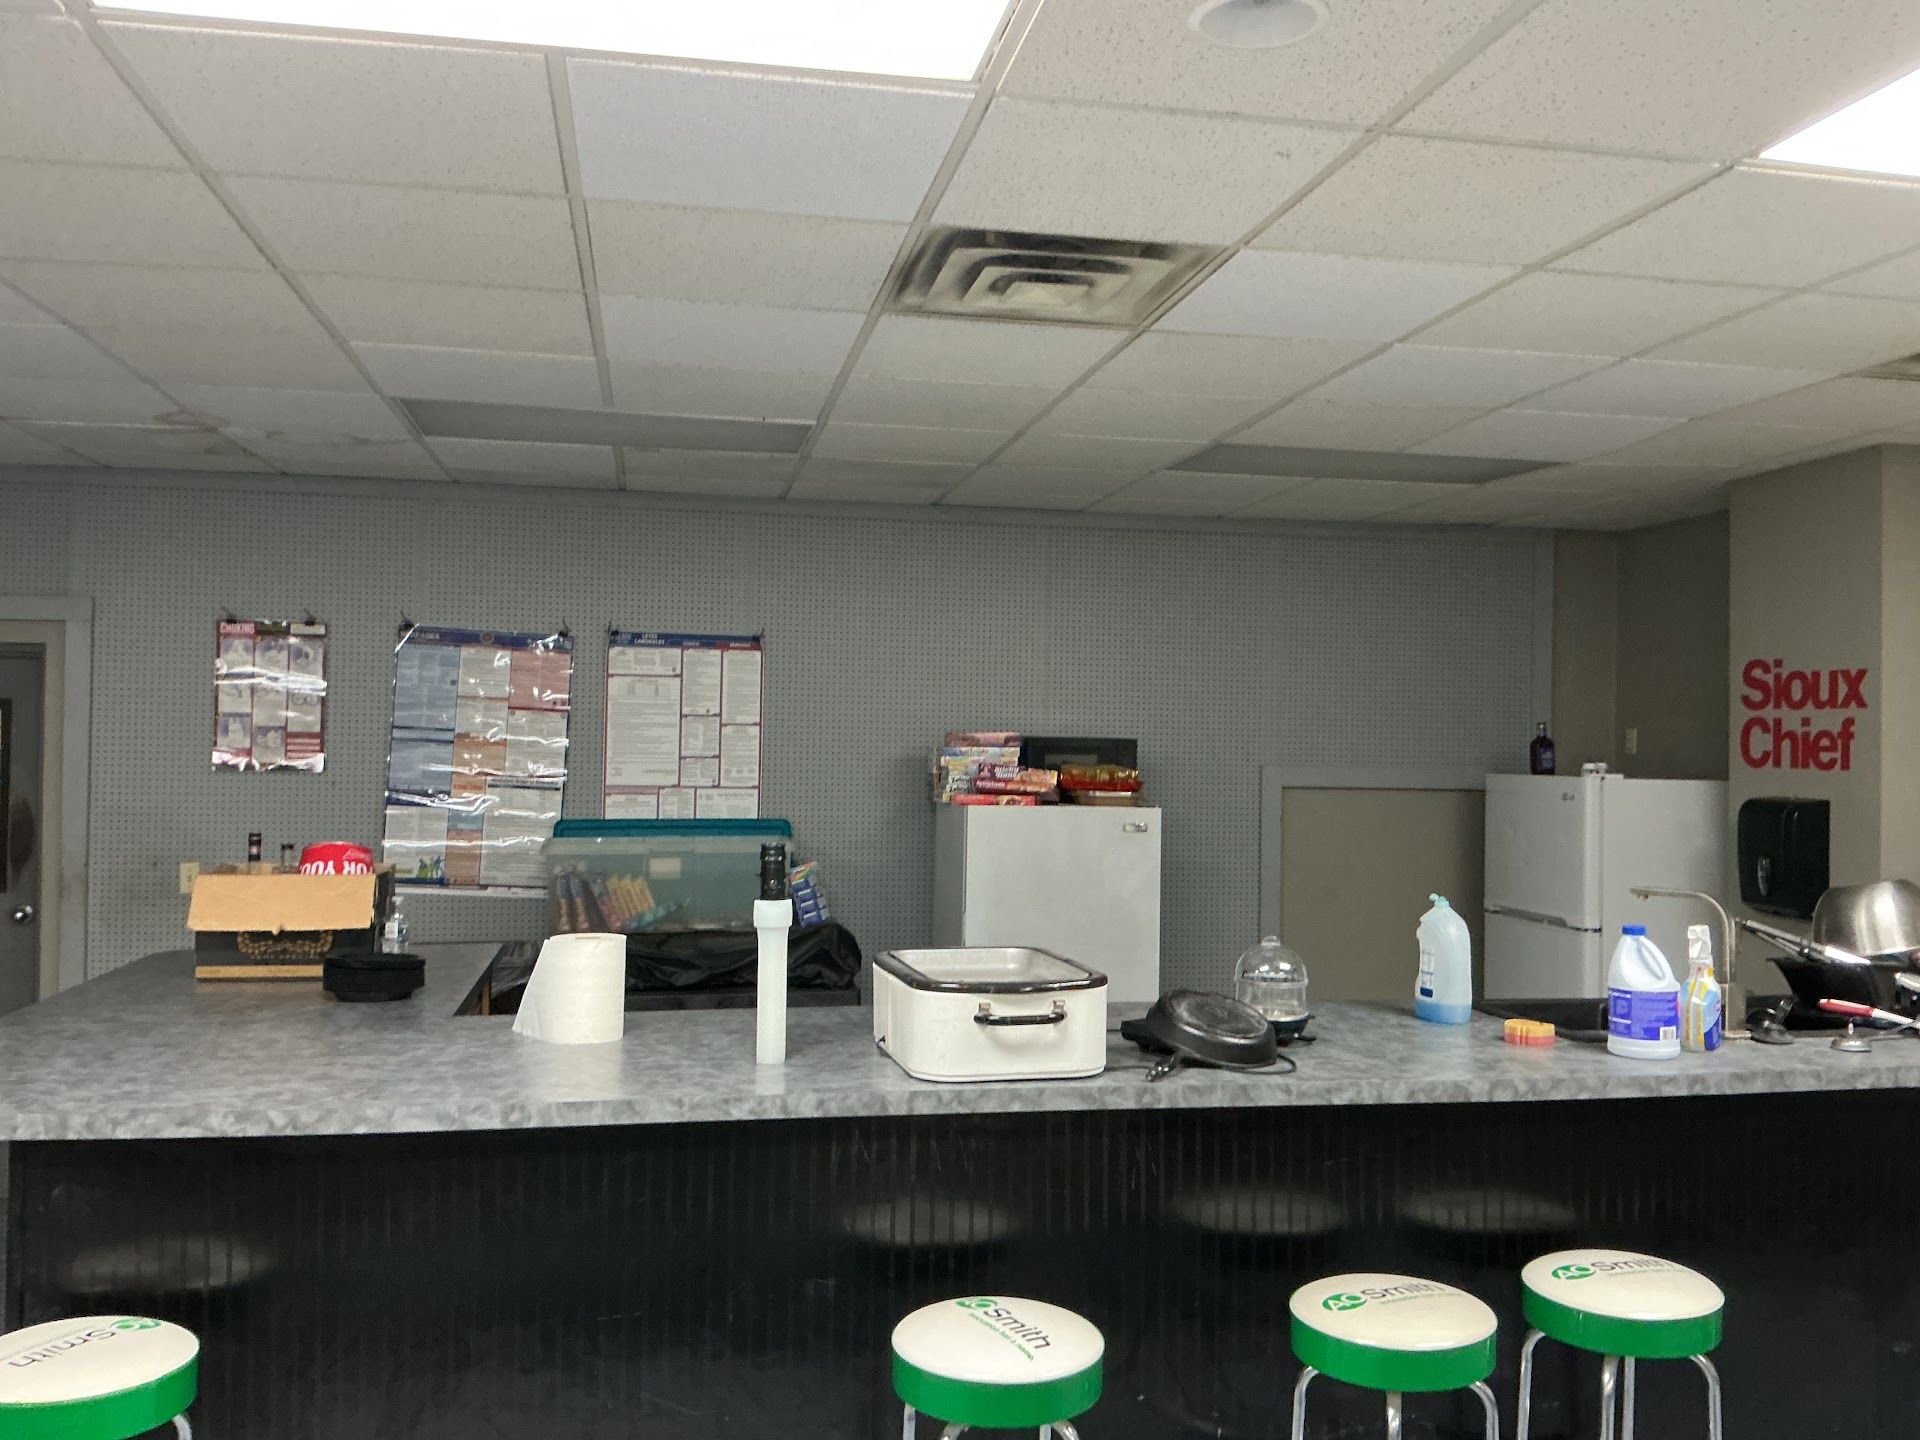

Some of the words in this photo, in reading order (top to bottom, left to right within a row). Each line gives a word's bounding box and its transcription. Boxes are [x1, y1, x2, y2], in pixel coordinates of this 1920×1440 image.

[1741, 659, 1868, 712] Sioux
[1740, 716, 1856, 771] Chief
[8, 1328, 117, 1367] Smith
[983, 1308, 1051, 1349] Smith
